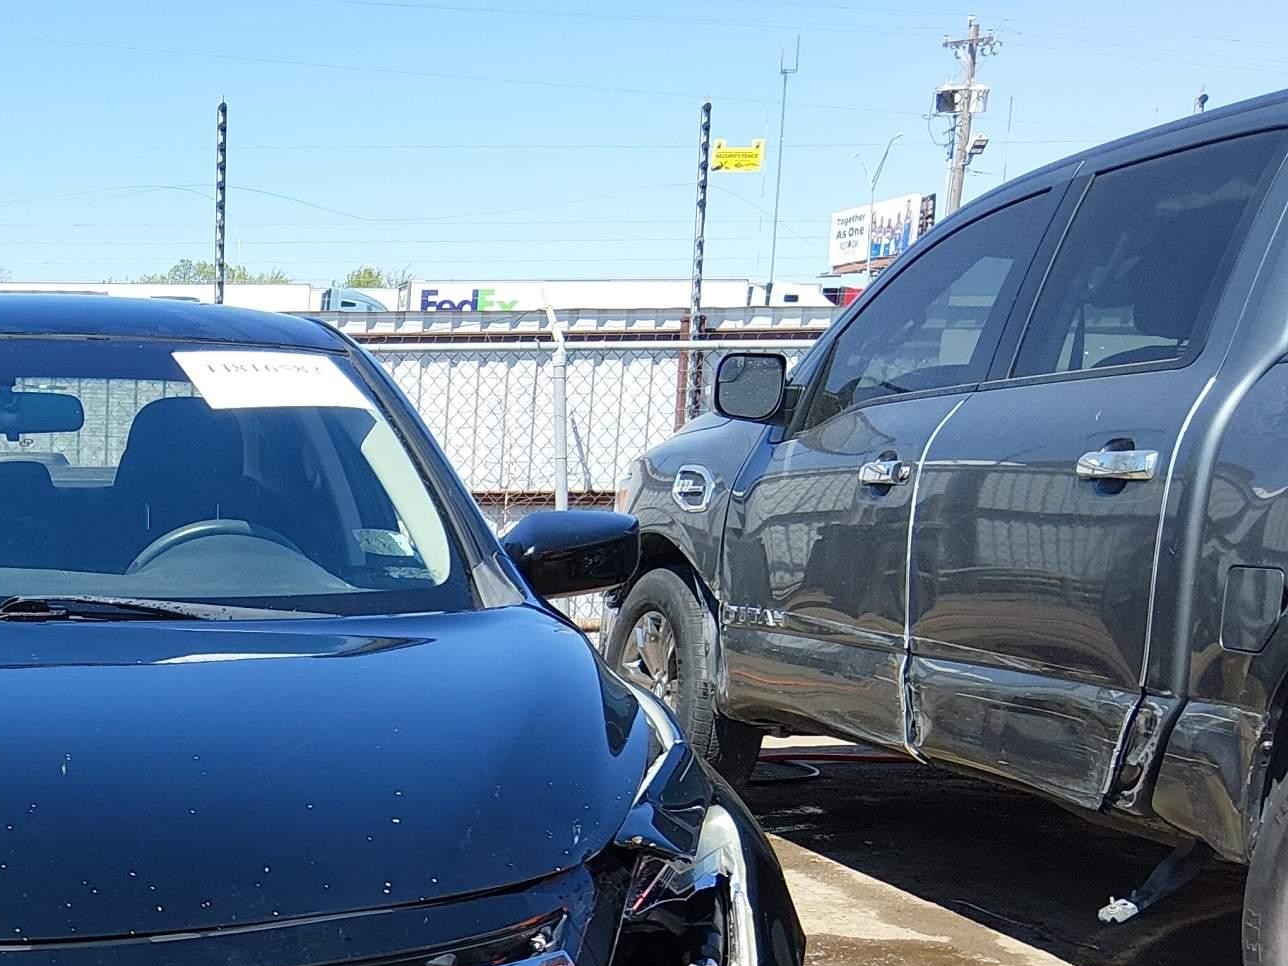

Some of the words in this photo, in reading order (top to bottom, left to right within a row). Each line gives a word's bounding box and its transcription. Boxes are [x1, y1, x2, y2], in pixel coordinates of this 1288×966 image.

[837, 213, 866, 226] Together
[836, 230, 847, 240] As
[848, 226, 865, 237] One
